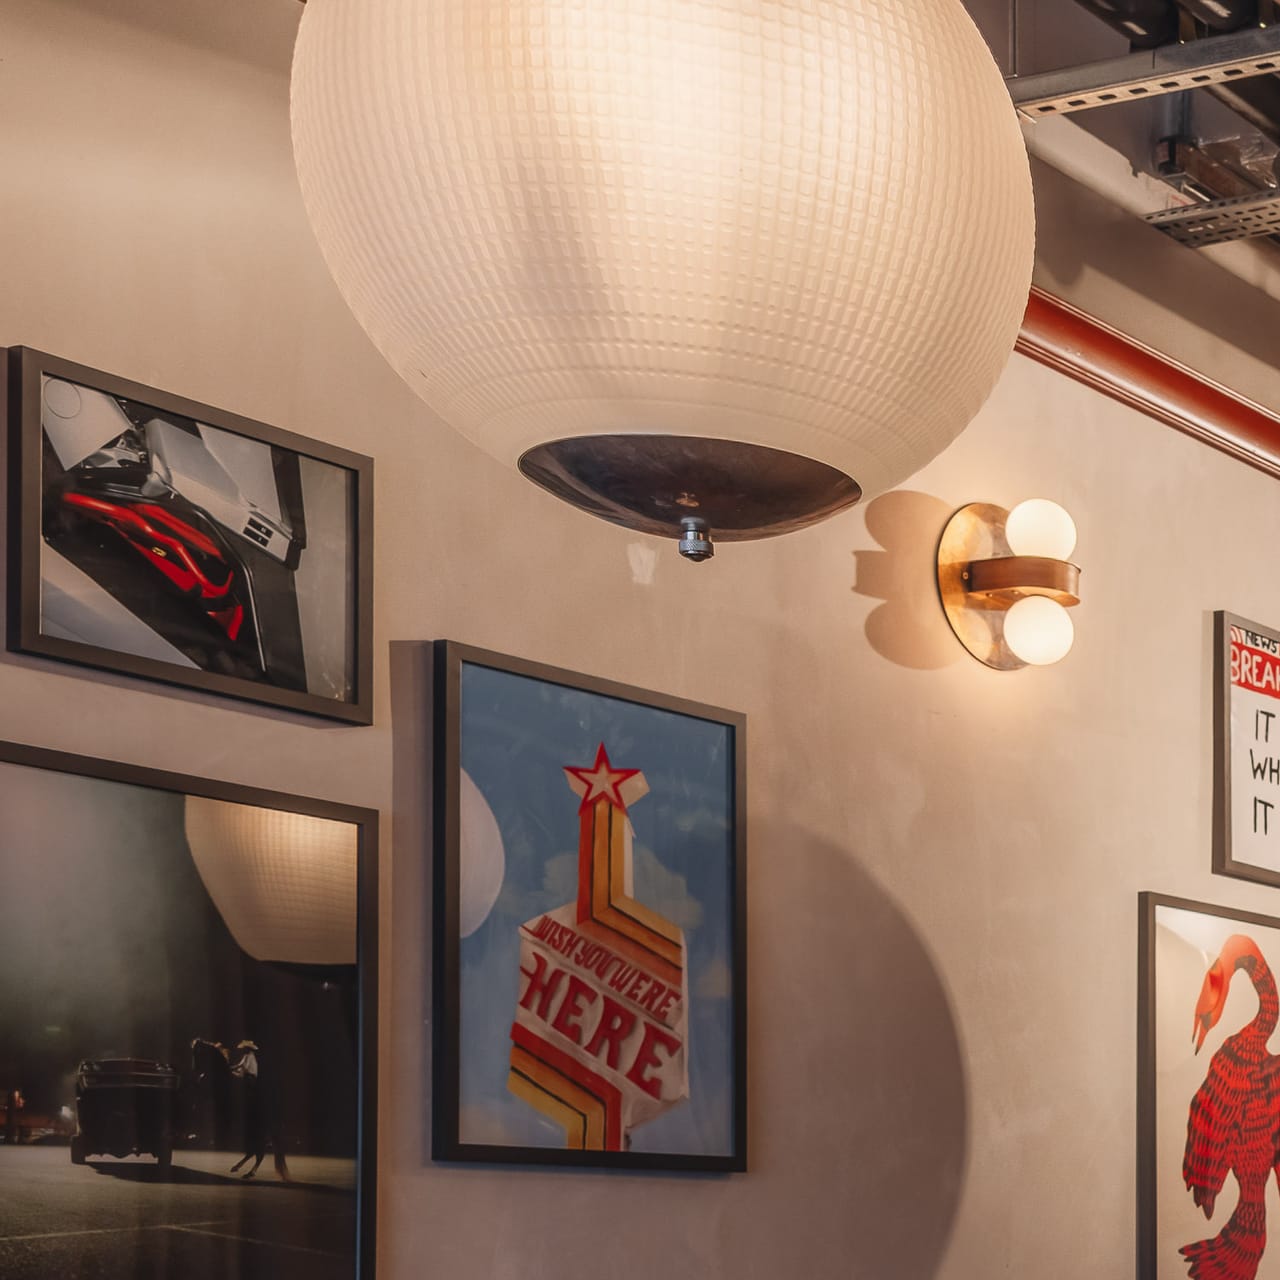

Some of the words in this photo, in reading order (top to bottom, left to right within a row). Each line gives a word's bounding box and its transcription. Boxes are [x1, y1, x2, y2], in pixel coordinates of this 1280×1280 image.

[1244, 631, 1277, 654] NEWS
[1255, 709, 1276, 743] IT
[1253, 796, 1274, 835] IT
[536, 915, 578, 959] WISH
[576, 940, 608, 981] YOU
[607, 959, 682, 1021] WERE
[518, 951, 683, 1101] HERE
